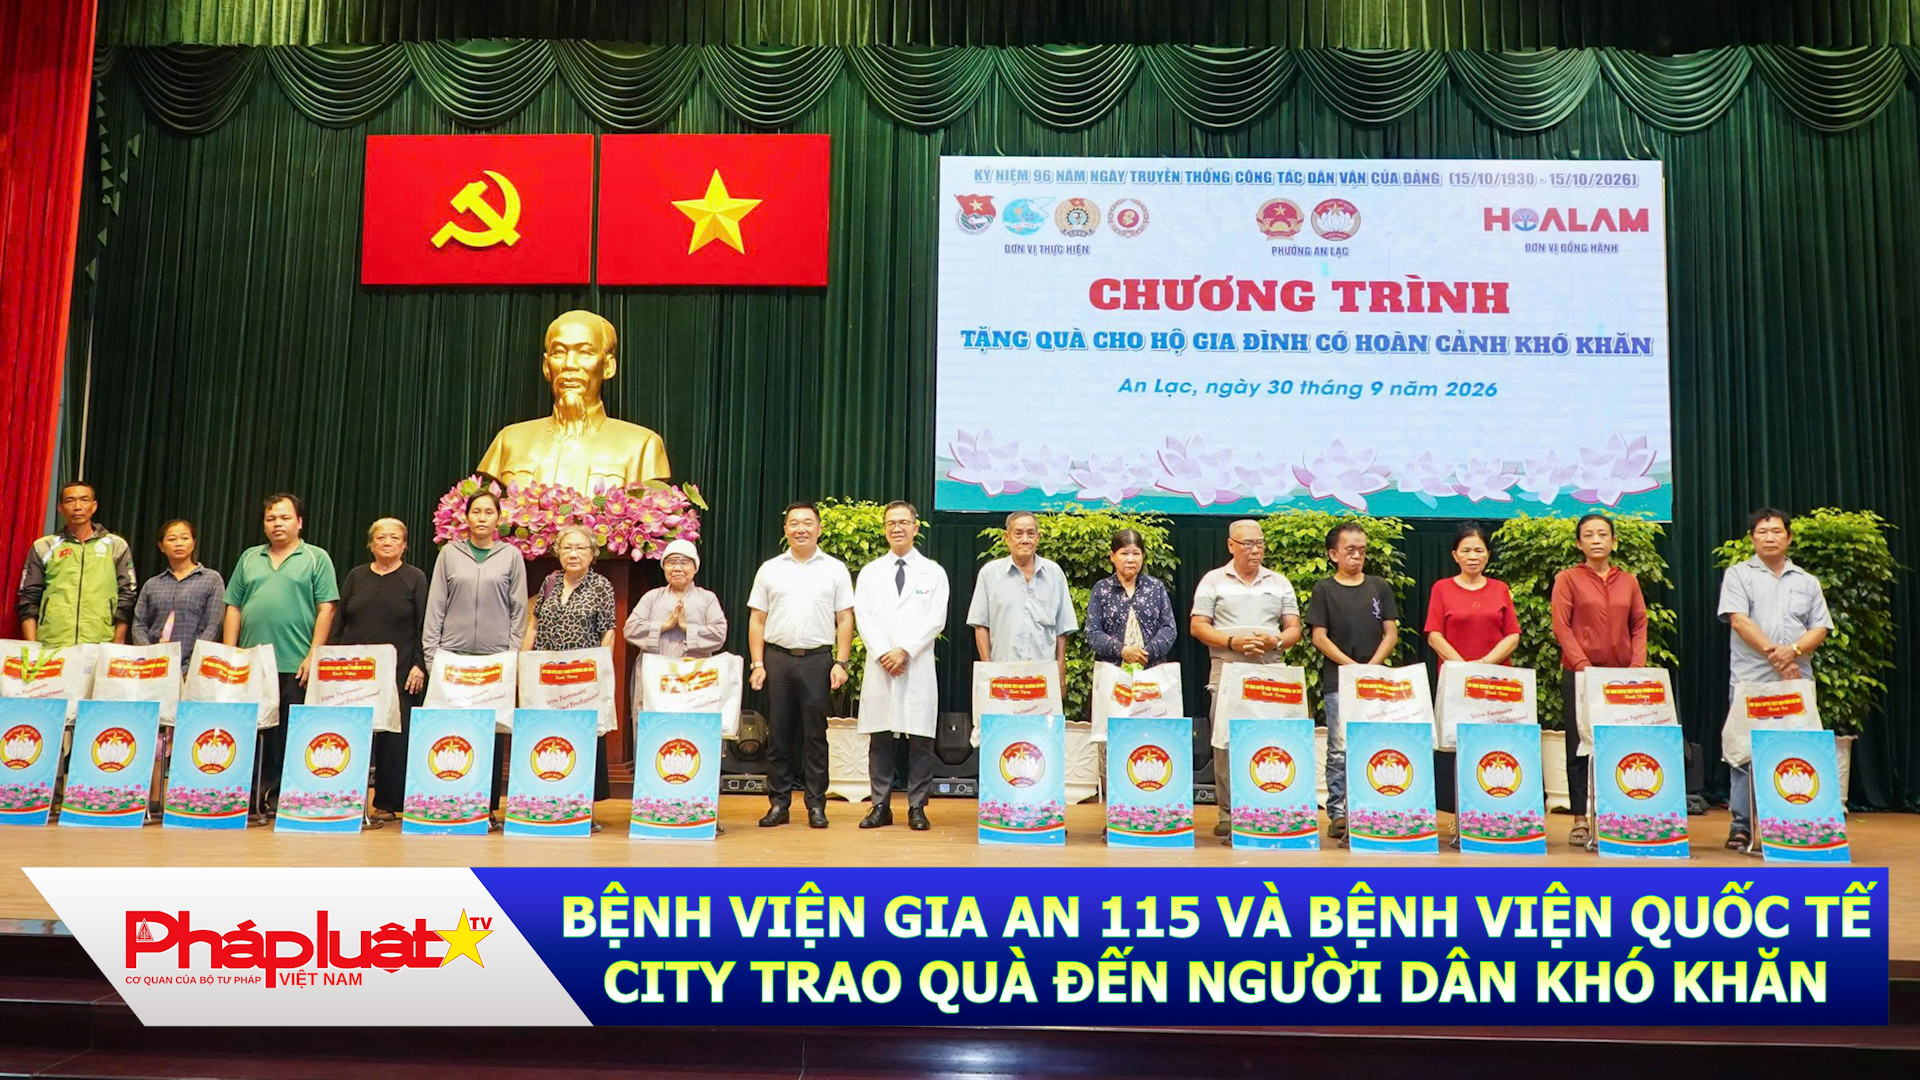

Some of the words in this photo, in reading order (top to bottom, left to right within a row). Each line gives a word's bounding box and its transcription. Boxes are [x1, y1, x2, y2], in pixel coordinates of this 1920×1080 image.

[996, 168, 1029, 186] NIỆM
[1033, 169, 1051, 183] 96
[1056, 168, 1086, 183] NĂM
[1090, 168, 1126, 183] NGÀY
[1130, 167, 1180, 183] TRUYỀN
[1185, 167, 1230, 183] THỐNG
[1235, 168, 1273, 184] CÔNG
[1277, 169, 1303, 184] TÁC
[1307, 169, 1335, 184] DÂN
[1339, 169, 1366, 188] VẬN
[1371, 168, 1399, 185] CỦA
[1402, 168, 1441, 185] ĐẢNG
[1004, 243, 1024, 254] ĐƠN
[1027, 244, 1036, 256] VỊ
[1039, 243, 1063, 256] THỰC
[1066, 243, 1089, 256] HIỆN
[1271, 243, 1311, 256] PHƯỜNG
[1313, 246, 1328, 256] AN
[1330, 246, 1349, 259] LẠC
[1525, 242, 1545, 253] ĐƠN
[1548, 243, 1558, 255] VỊ
[1560, 240, 1588, 253] ĐỒNG
[1590, 241, 1618, 253] HÀNH
[1089, 274, 1316, 312] CHƯƠNG
[1332, 273, 1510, 314] TRÌNH
[960, 326, 1029, 352] TẶNG
[1036, 327, 1086, 350] QUÀ
[1093, 330, 1143, 350] CHO
[1150, 328, 1186, 354] HỘ
[1193, 331, 1236, 351] GIA
[1243, 329, 1308, 351] ĐÌNH
[1315, 330, 1350, 351] CÓ
[1355, 331, 1428, 352] HOÀN
[1435, 329, 1507, 353] CẢNH
[1515, 331, 1568, 354] KHÓ
[1576, 332, 1651, 355] KHĂN
[1118, 378, 1147, 393] An
[1154, 378, 1197, 397] Lạc,
[1205, 378, 1261, 398] ngày
[1267, 380, 1294, 395] 30
[1299, 379, 1363, 400] tháng
[1370, 381, 1384, 396] 9
[1389, 381, 1438, 396] năm
[1445, 382, 1498, 397] 2026
